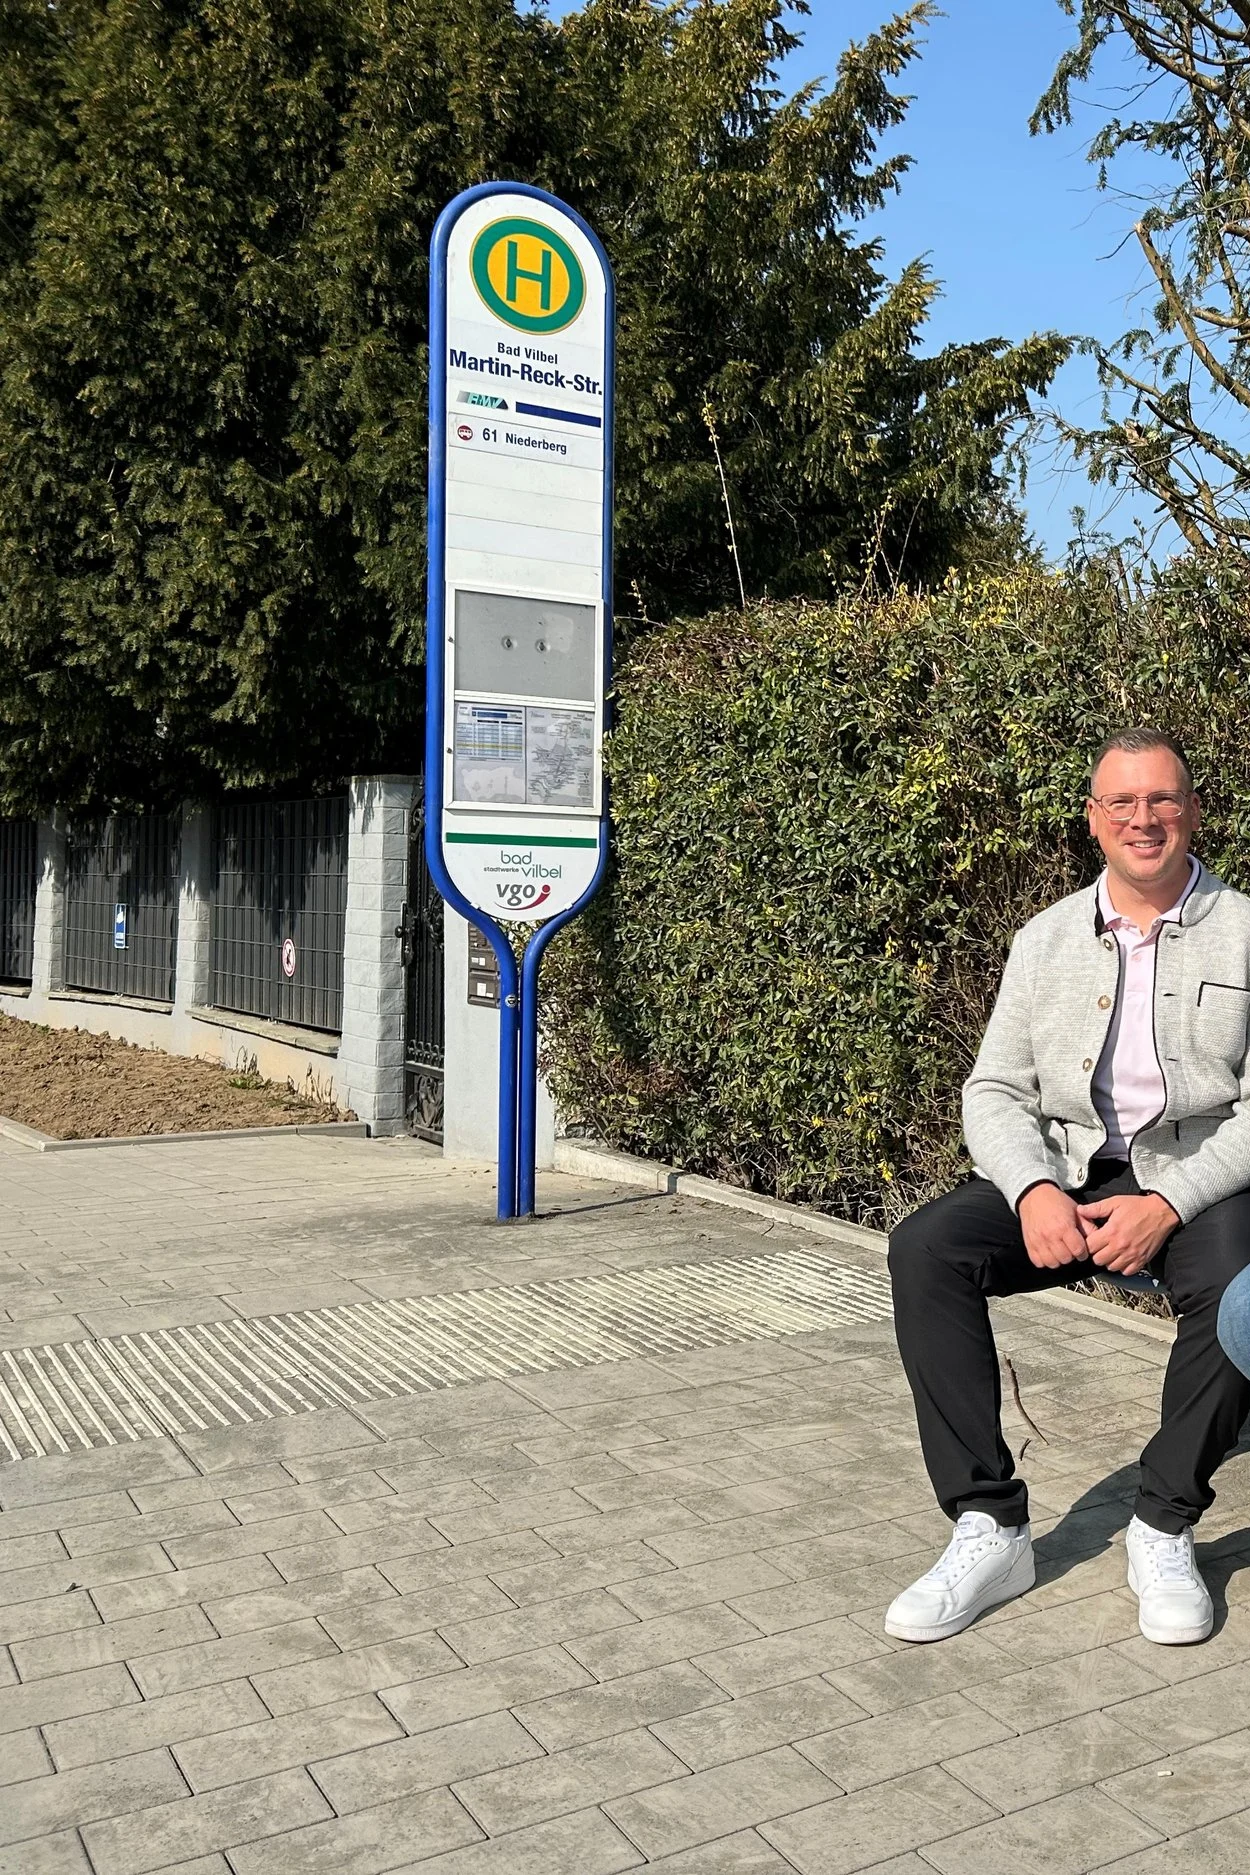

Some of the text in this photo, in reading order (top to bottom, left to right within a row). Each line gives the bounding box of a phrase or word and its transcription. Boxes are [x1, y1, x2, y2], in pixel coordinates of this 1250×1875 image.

[506, 240, 552, 311] H
[497, 342, 558, 365] Bad Vilbel
[449, 348, 603, 396] Martin-Reck-Str.
[482, 427, 567, 455] 61 Niederberg
[500, 850, 532, 865] bad
[521, 864, 562, 879] vilbel
[496, 883, 536, 907] vgo
